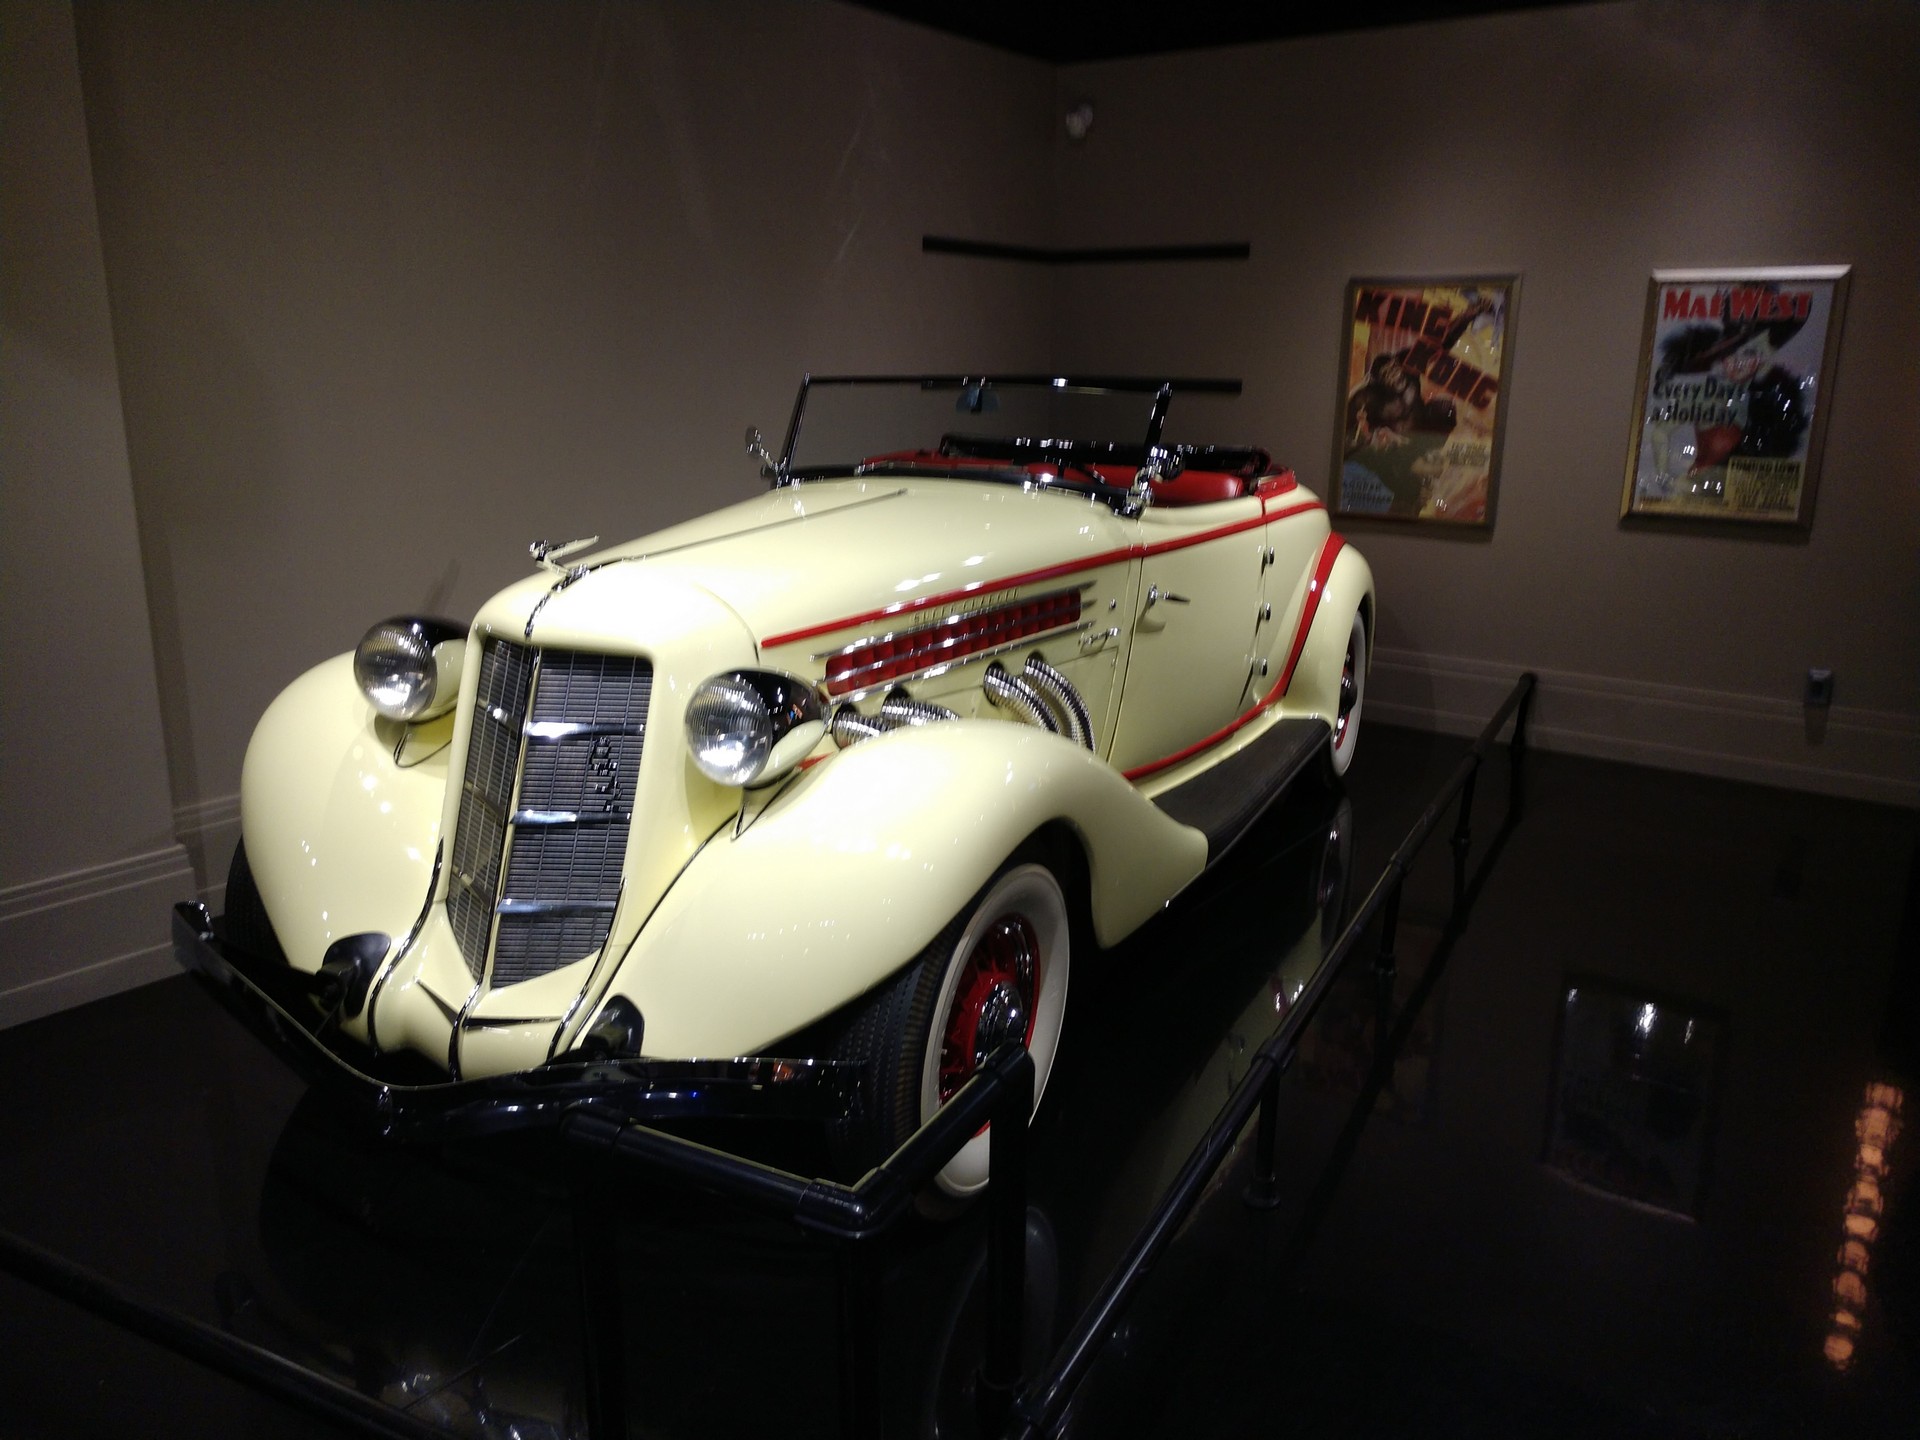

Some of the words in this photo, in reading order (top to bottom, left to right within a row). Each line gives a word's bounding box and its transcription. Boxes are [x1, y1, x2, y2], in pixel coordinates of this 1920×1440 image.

[1355, 288, 1454, 339] KING
[1730, 286, 1813, 320] WEST
[1403, 339, 1498, 411] KONG
[1653, 368, 1702, 401] Every
[1663, 397, 1739, 425] Holiday
